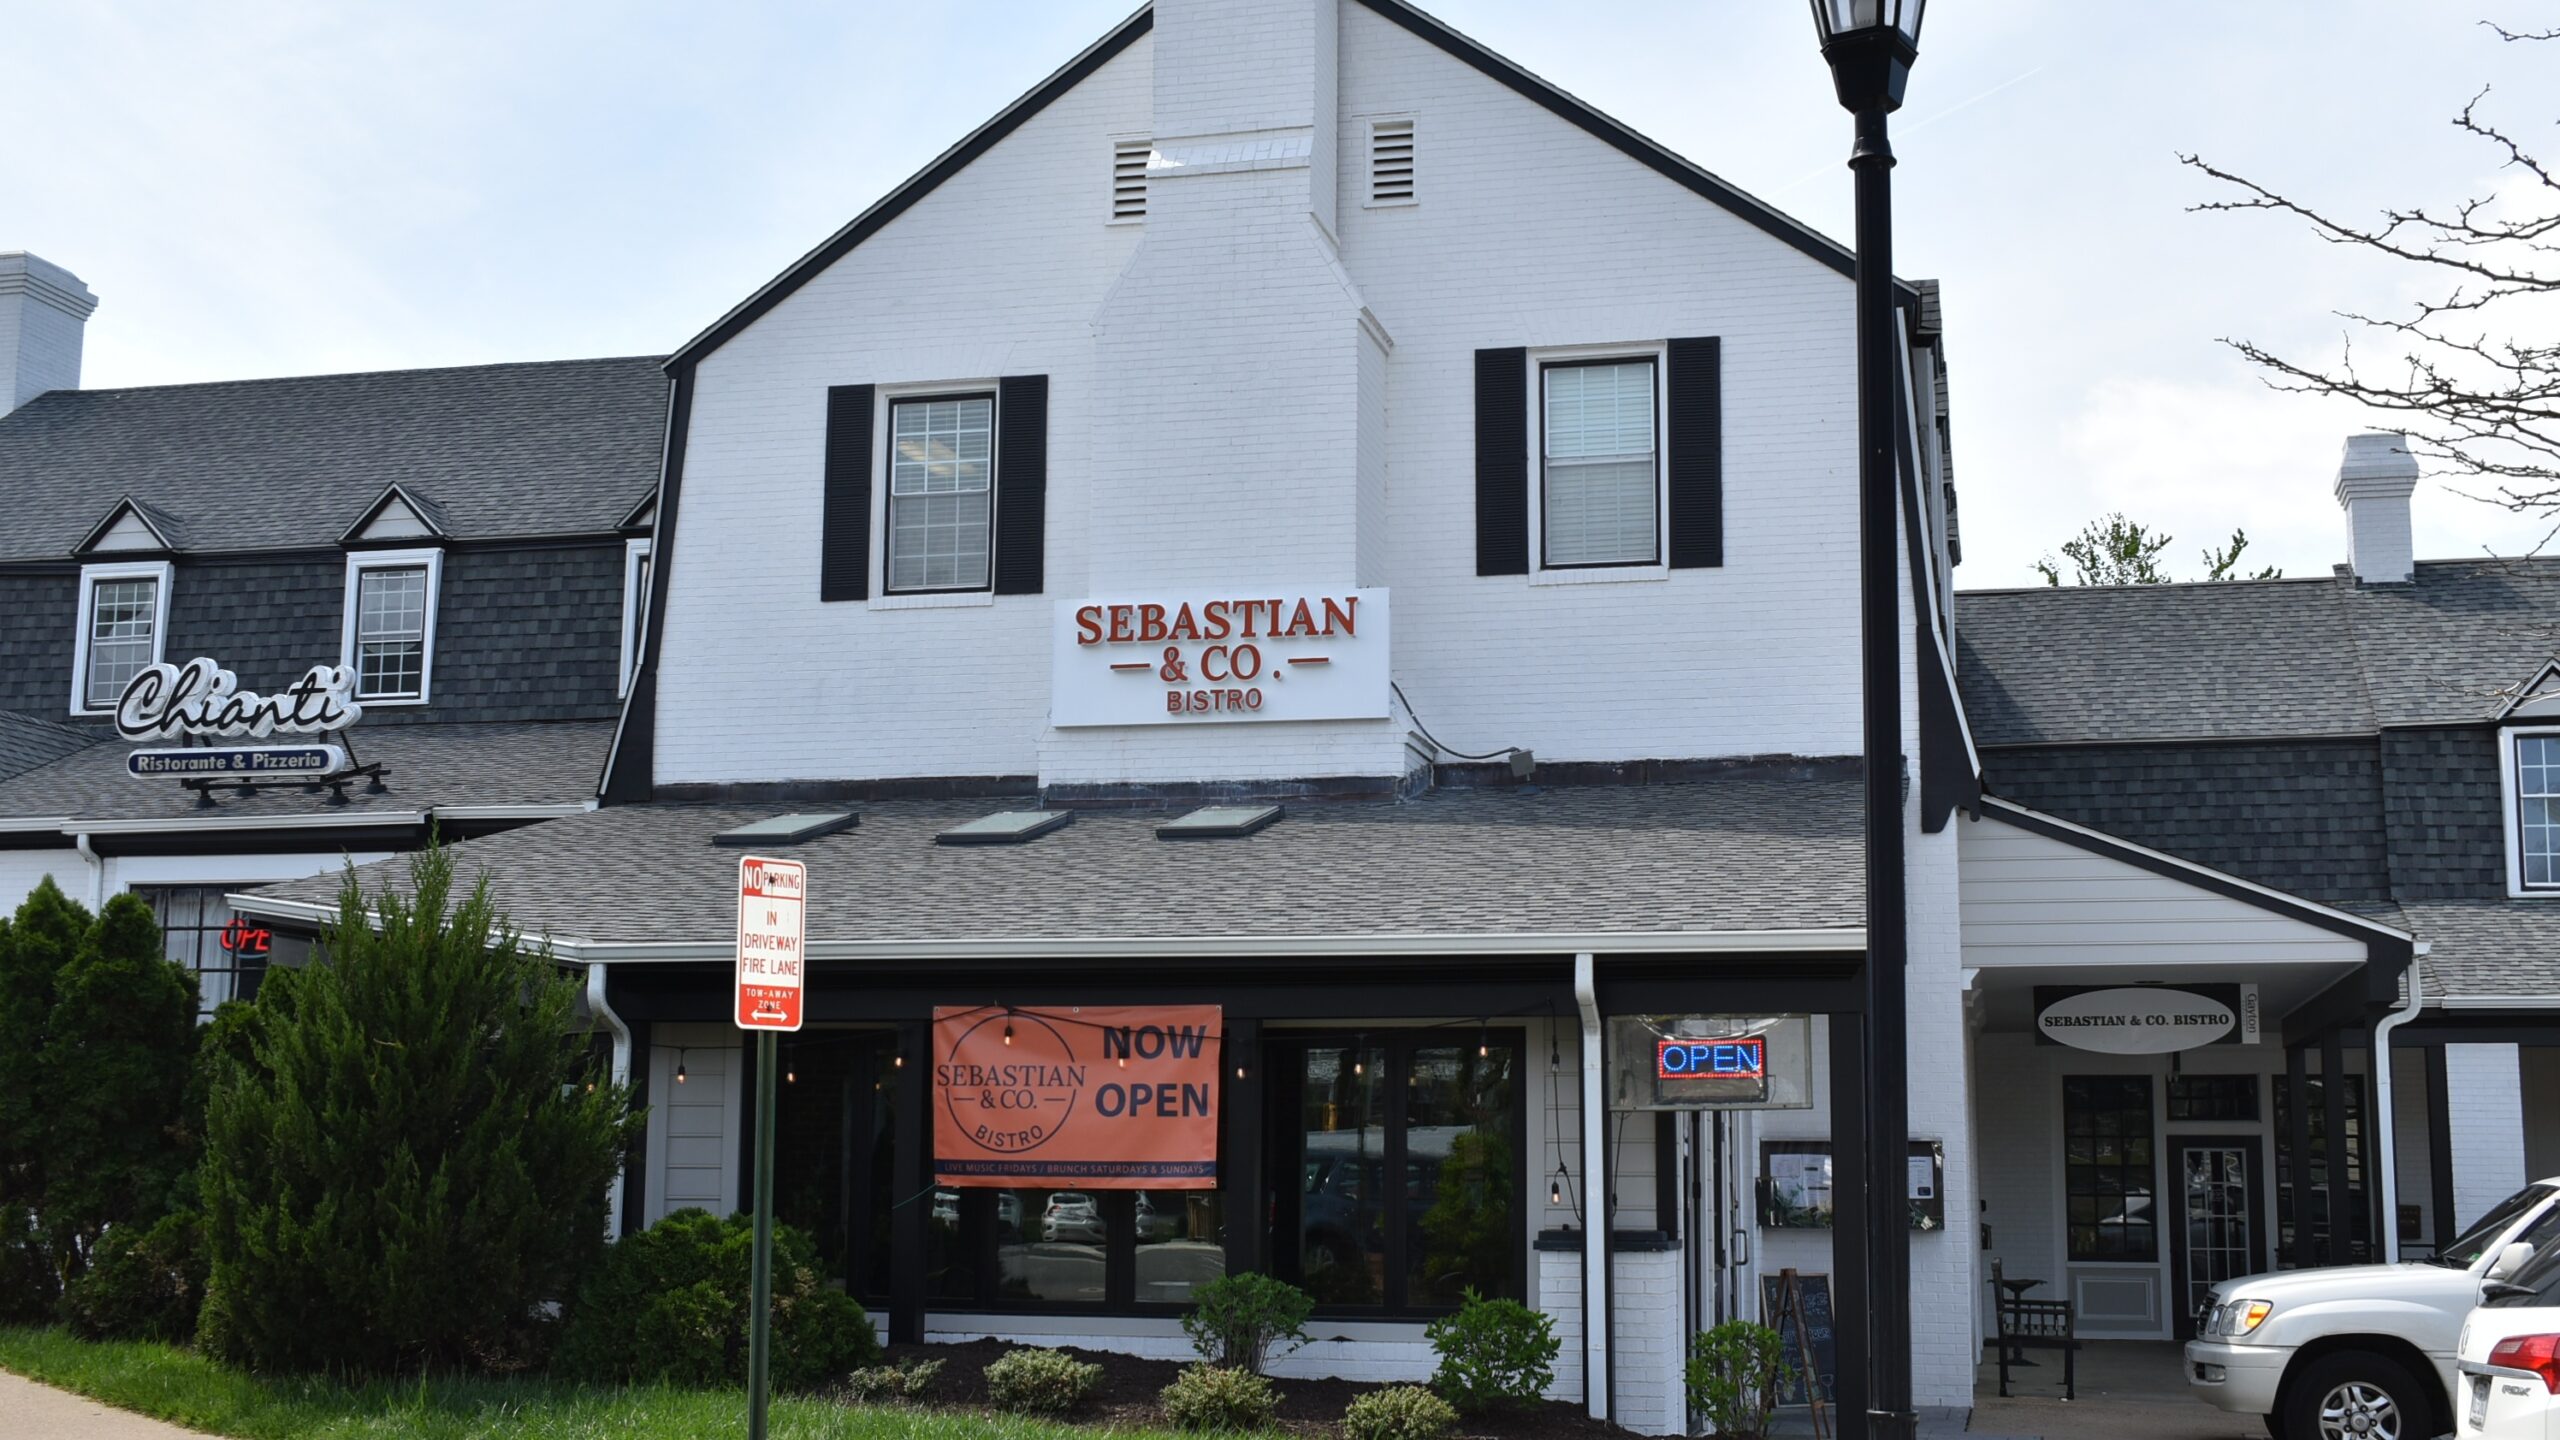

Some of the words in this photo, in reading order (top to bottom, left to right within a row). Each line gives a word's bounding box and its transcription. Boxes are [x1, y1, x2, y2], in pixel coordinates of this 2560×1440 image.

[1075, 597, 1359, 645] SEBASTIAN
[1160, 646, 1188, 682] &
[116, 662, 347, 737] Chianti
[1167, 688, 1263, 713] BISTRO
[137, 755, 226, 772] Ristorante
[232, 754, 246, 769] &
[252, 752, 321, 769] Pizzeria
[744, 865, 762, 890] NO
[763, 871, 800, 890] PARKING
[767, 911, 777, 926] IN
[745, 933, 798, 952] DRIVEWAY
[743, 957, 766, 974] FIRE
[771, 959, 798, 976] LANE
[746, 988, 794, 999] TOW-AWAY
[758, 1000, 781, 1009] ZONE
[2045, 1015, 2126, 1027] SEBASTIAN
[2130, 1015, 2142, 1026] &
[2146, 1014, 2169, 1026] CO.
[2174, 1014, 2230, 1026] BISTRO
[1103, 1025, 1206, 1060] NOW
[1662, 1045, 1758, 1072] OPEN
[937, 1064, 1086, 1088] SEBASTIAN
[980, 1089, 996, 1109] &
[1000, 1089, 1038, 1109] CO.
[1095, 1082, 1209, 1118] OPEN
[975, 1124, 1044, 1148] BISTRO
[944, 1163, 964, 1172] LIVE
[966, 1164, 996, 1173] MUSIC
[999, 1164, 1037, 1173] FRIDAYS
[1040, 1164, 1044, 1173] /
[1048, 1164, 1087, 1174] BRUNCH
[1091, 1165, 1148, 1174] SATURDAYS
[1150, 1165, 1157, 1174] &
[1161, 1165, 1205, 1174] SUNDAYS
